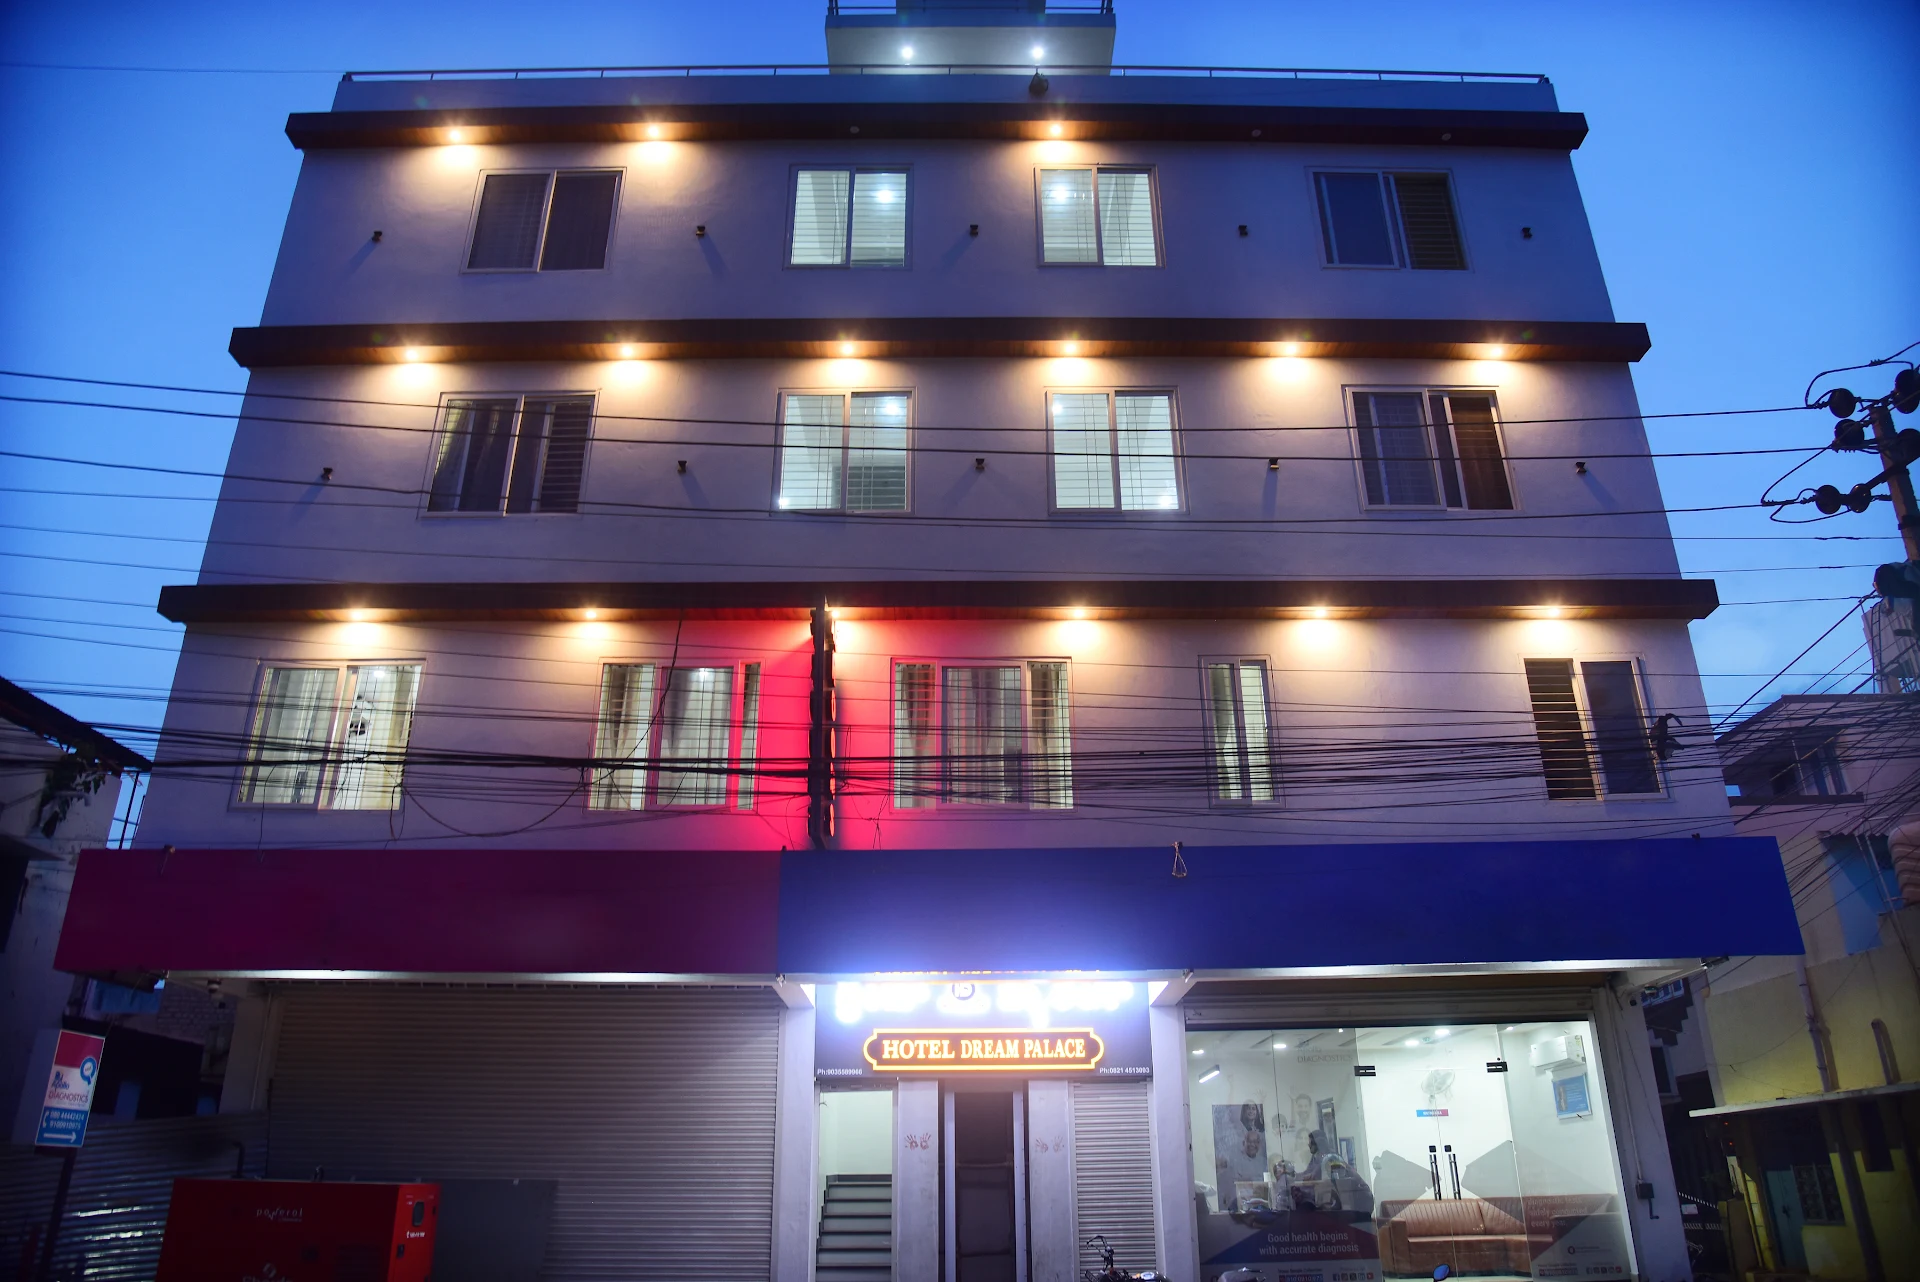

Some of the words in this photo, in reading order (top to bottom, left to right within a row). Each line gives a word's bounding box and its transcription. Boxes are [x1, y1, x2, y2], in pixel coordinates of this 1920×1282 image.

[882, 1039, 955, 1059] HOTEL
[961, 1039, 1019, 1059] DREAM
[1024, 1038, 1086, 1058] PALACE
[1297, 1054, 1353, 1063] DIAGNOSTICS
[48, 1091, 89, 1103] DIAGNOSTICS
[1531, 1220, 1550, 1229] every
[1267, 1232, 1290, 1243] Good
[1291, 1231, 1318, 1242] health
[1320, 1230, 1349, 1243] begins
[1259, 1245, 1278, 1256] with
[1279, 1245, 1316, 1255] accurate
[1318, 1242, 1359, 1255] diagnosis
